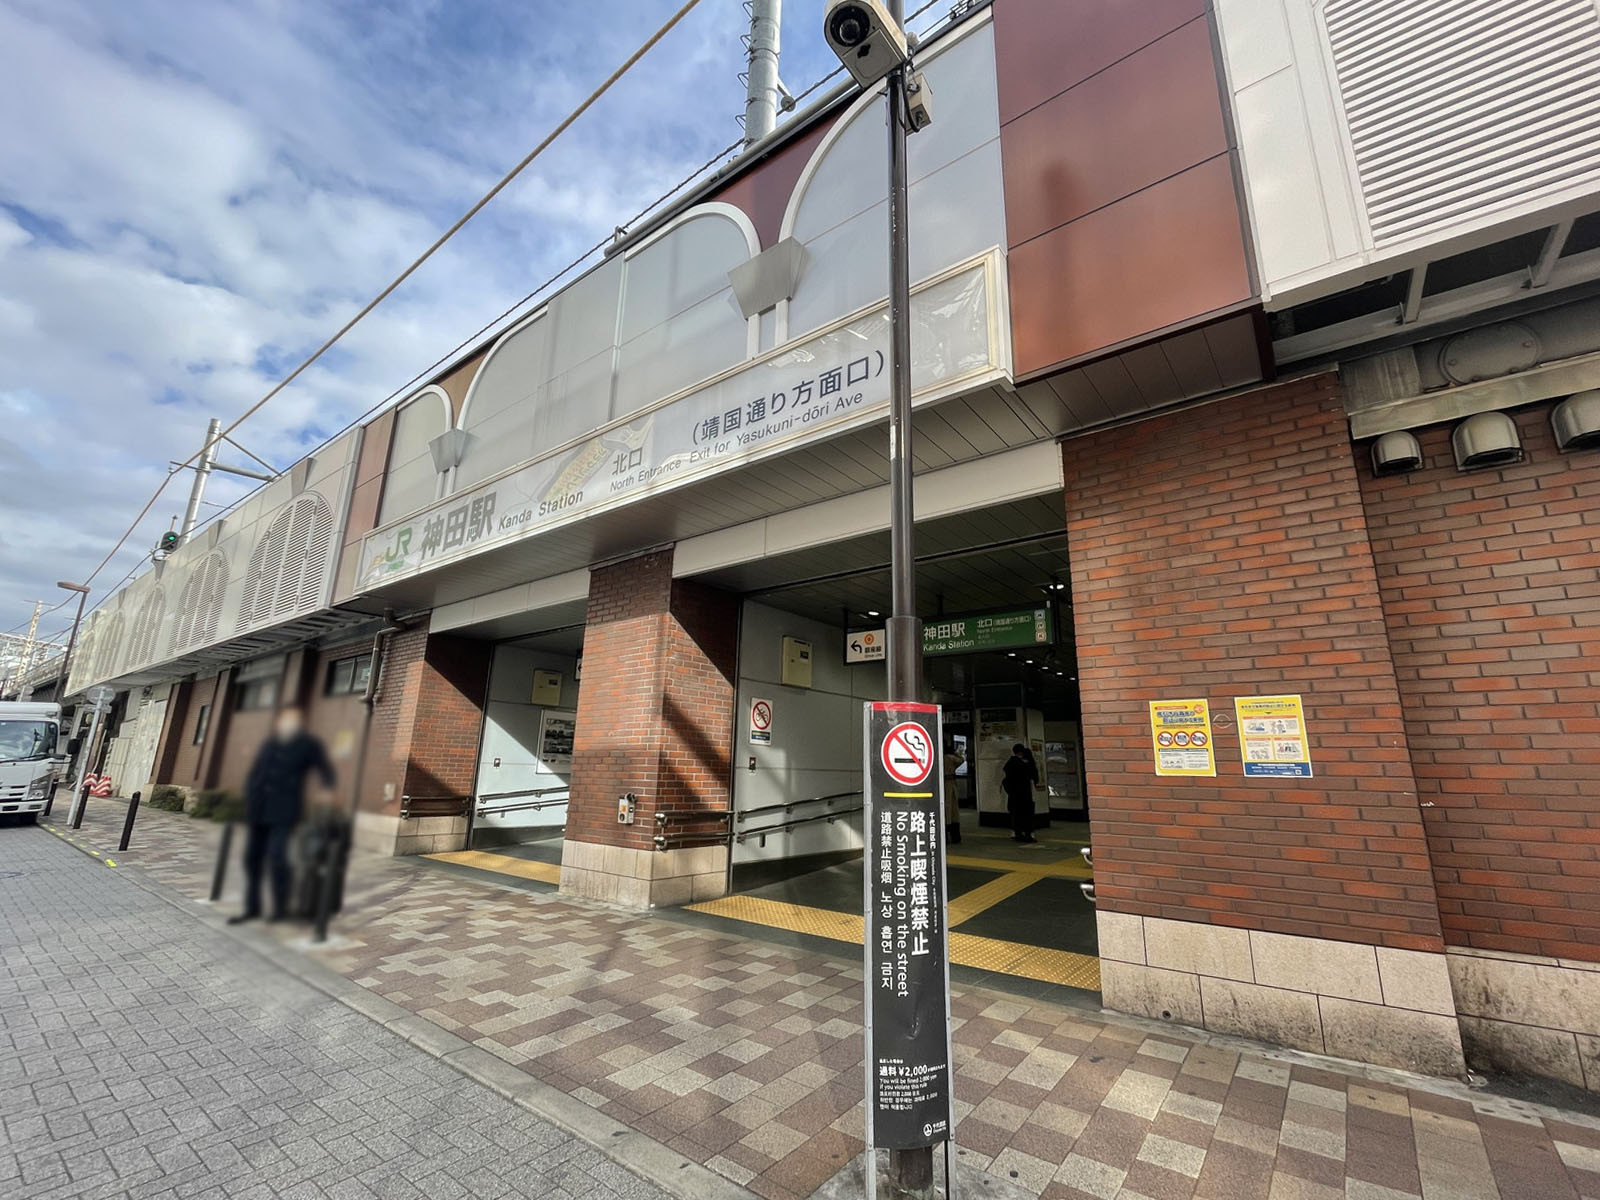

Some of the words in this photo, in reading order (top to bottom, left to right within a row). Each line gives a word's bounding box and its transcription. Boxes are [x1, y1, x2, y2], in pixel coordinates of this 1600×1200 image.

[689, 446, 711, 464] Exit
[714, 440, 731, 455] for
[736, 402, 830, 447] Yasukuni-dōri
[834, 392, 863, 412] Ave
[610, 475, 635, 493] North
[638, 459, 682, 482] Entrance
[612, 447, 643, 476] 北口
[499, 508, 533, 531] Kanda
[538, 490, 584, 518] Station
[421, 491, 498, 561] 神田駅
[386, 527, 413, 563] JR
[923, 622, 966, 641] 神田駅
[976, 618, 993, 629] 北口
[923, 642, 947, 652] Kanda
[948, 639, 975, 649] Station
[896, 811, 909, 832] No
[880, 810, 893, 884] 道路禁止吸烟
[893, 834, 910, 897] Smoking
[910, 809, 930, 956] 路上喫煙禁止
[880, 890, 894, 919] 노상
[896, 900, 907, 920] on
[880, 925, 894, 954] 흡연
[896, 923, 910, 949] the
[880, 962, 894, 991] 금지
[897, 952, 910, 998] street
[898, 1064, 928, 1078] ¥2,000
